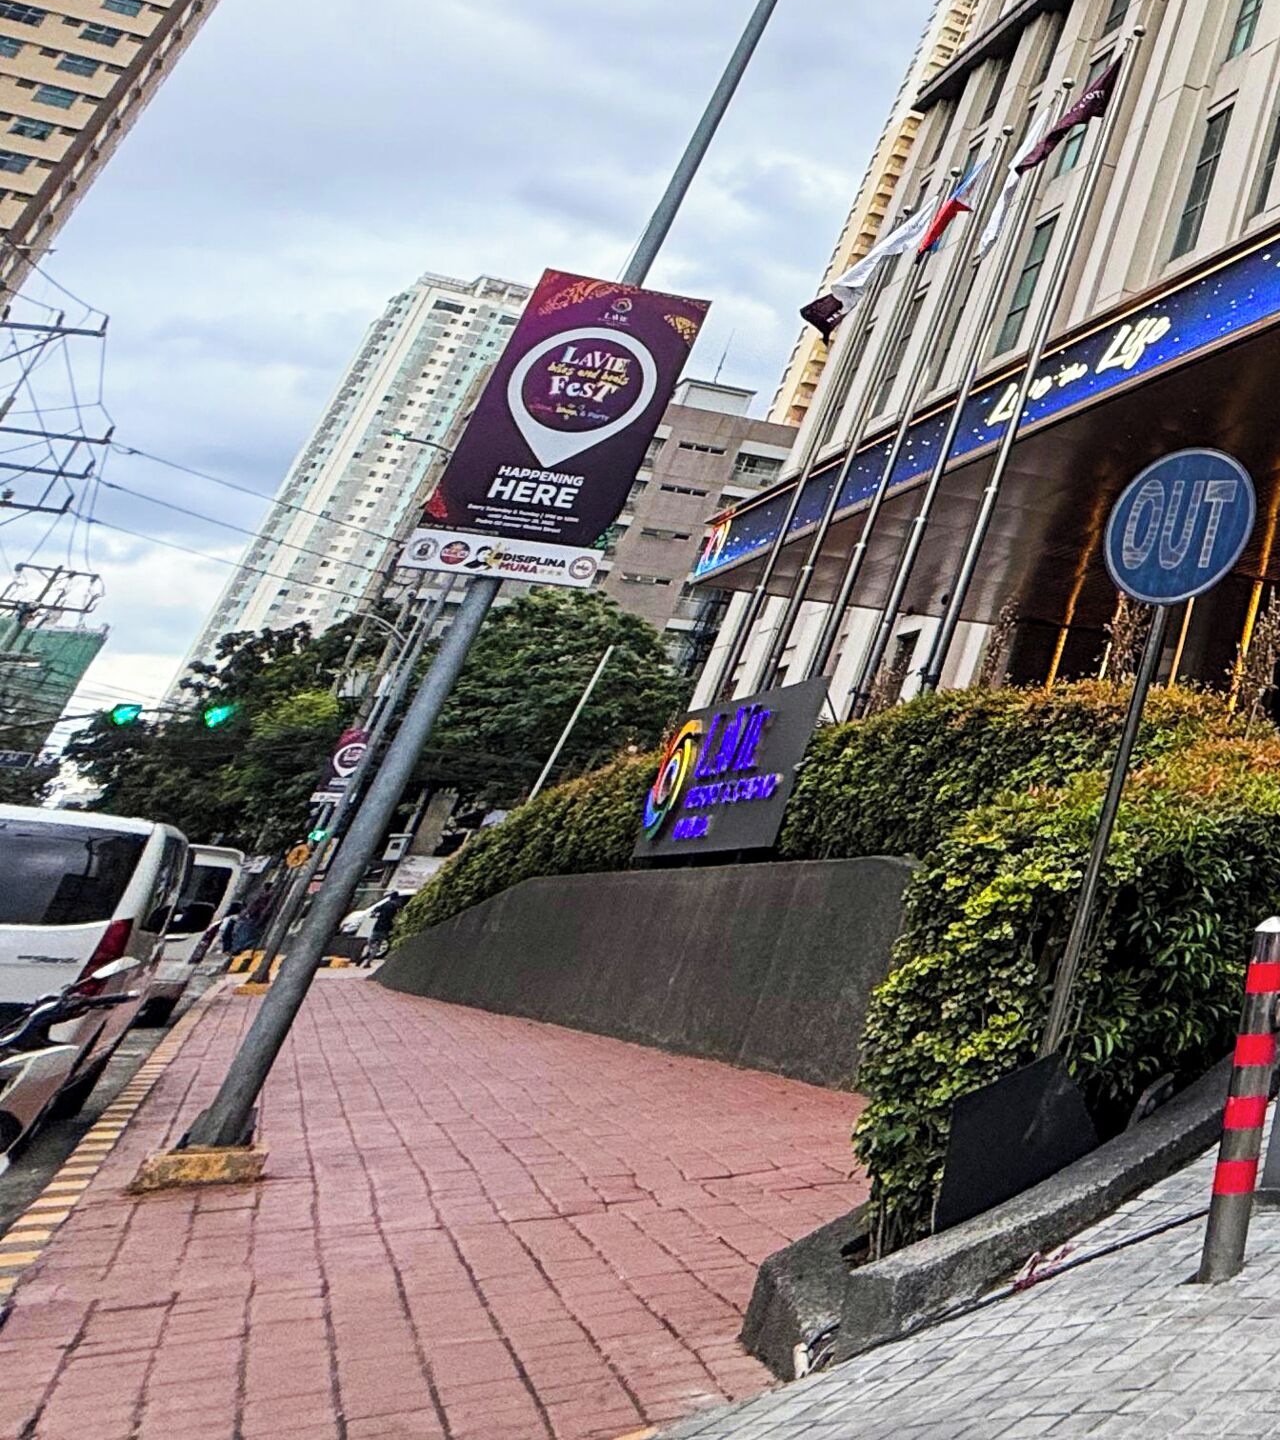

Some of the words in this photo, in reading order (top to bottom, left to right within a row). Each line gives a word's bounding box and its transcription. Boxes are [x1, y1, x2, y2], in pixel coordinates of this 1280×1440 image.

[1095, 315, 1172, 375] Life
[577, 369, 598, 379] and
[497, 464, 585, 487] HAPPENING
[486, 477, 580, 509] HERE
[1121, 478, 1239, 571] OUT
[494, 550, 567, 569] #DISIPLINA
[497, 561, 539, 575] MUNA
